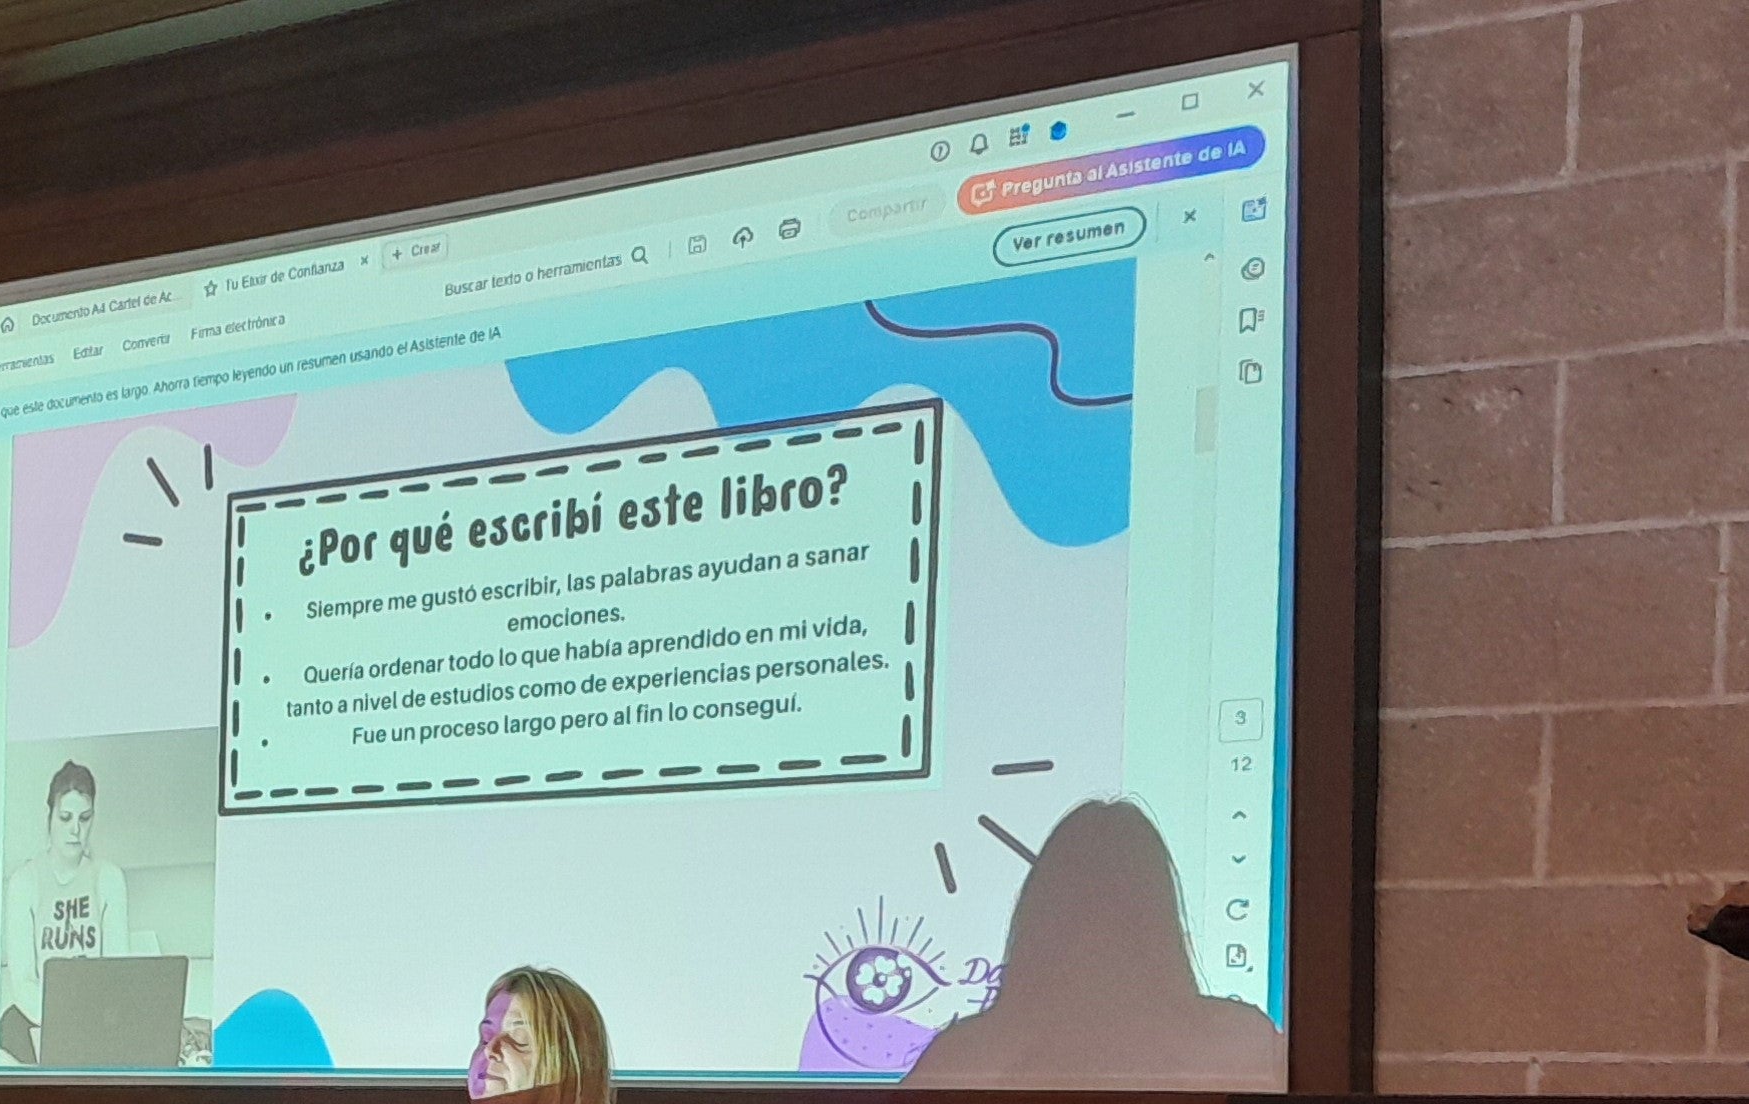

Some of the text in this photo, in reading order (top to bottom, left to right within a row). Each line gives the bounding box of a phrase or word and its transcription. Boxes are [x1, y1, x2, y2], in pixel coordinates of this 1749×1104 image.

[1002, 140, 1247, 199] Pregunta al Asistente de IA
[847, 196, 928, 223] Compartir
[411, 241, 441, 257] Crear
[1013, 221, 1126, 252] Ver resumen
[226, 278, 239, 292] Tu
[271, 270, 285, 284] de
[288, 259, 345, 281] Confianza
[445, 254, 623, 297] Buscar texto o herramientas
[32, 306, 90, 328] Documento
[109, 295, 141, 313] Cartel
[143, 293, 158, 306] de
[190, 313, 286, 340] Firma electrónica
[73, 344, 104, 359] Editar
[0, 405, 20, 420] que
[23, 398, 44, 412] este
[46, 390, 104, 411] documento
[106, 389, 119, 401] es
[153, 377, 190, 393] Ahorra
[192, 371, 230, 389] tiempo
[232, 363, 277, 383] leyendo
[280, 360, 294, 374] un
[297, 353, 347, 372] resumen
[349, 345, 394, 363] usando
[397, 340, 408, 355] el
[410, 332, 466, 353] Asistente
[469, 328, 485, 344] de
[489, 325, 502, 340] IA
[299, 463, 848, 576] ¿Por qué escribí este libro?
[306, 543, 870, 620] Siempre me gustó escribir, las palabras ayudan a sanar
[507, 605, 626, 632] emociones.
[303, 613, 868, 684] Quería ordenar todo lo que había aprendido en mi vida,
[286, 651, 890, 718] tanto a nivel de estudios como de experiencias personales.
[352, 692, 803, 745] Fue un proceso largo pero al fin lo conseguí.
[1234, 709, 1247, 726] 3
[1230, 755, 1253, 772] 12
[53, 895, 91, 921] SHE
[41, 925, 96, 951] RUNS
